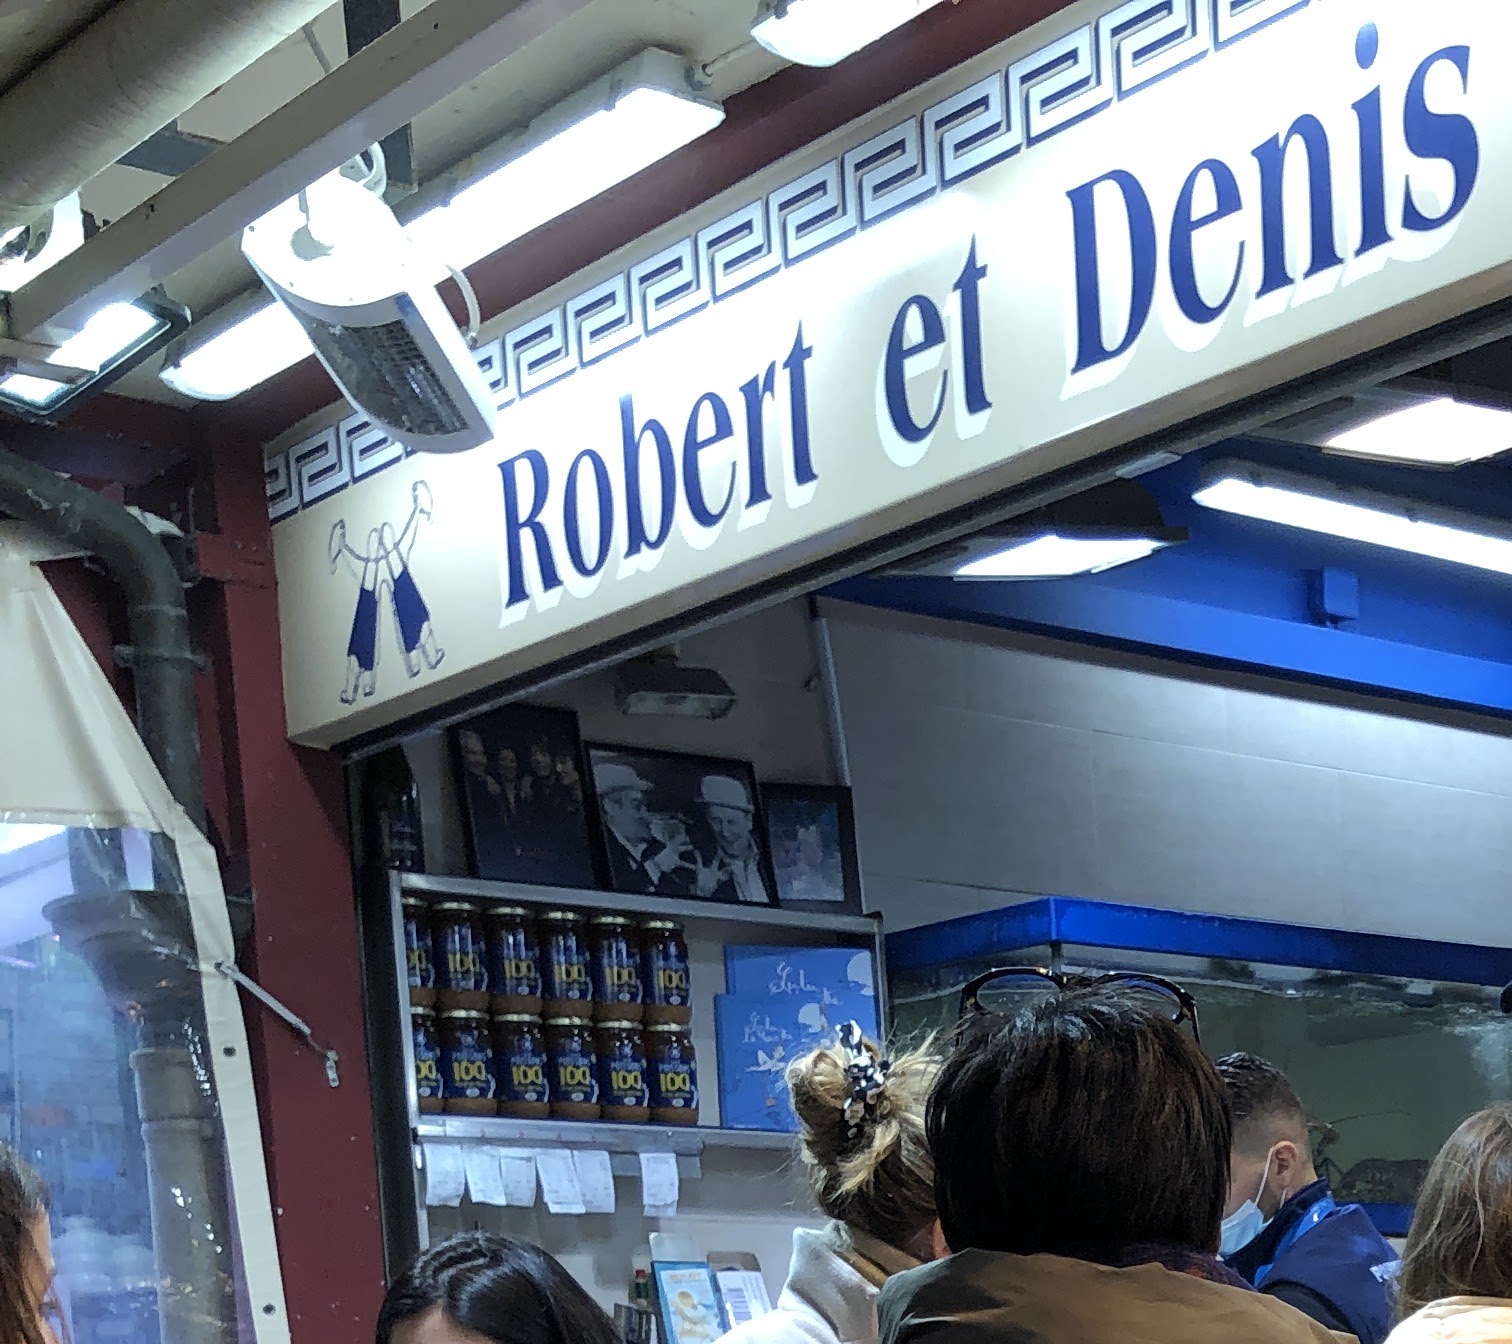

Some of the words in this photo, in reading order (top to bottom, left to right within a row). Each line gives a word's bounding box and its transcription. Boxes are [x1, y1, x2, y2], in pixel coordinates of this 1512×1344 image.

[498, 320, 818, 608] Robert
[885, 232, 992, 442] et
[1069, 21, 1480, 373] Denis
[504, 959, 535, 978] 100
[554, 963, 585, 982] 100
[605, 966, 636, 985] 100
[658, 970, 687, 988] 100
[453, 1061, 486, 1081] 100
[512, 1065, 543, 1085] 100
[560, 1065, 590, 1085] 100
[611, 1070, 642, 1089] 100
[660, 1072, 690, 1091] 100
